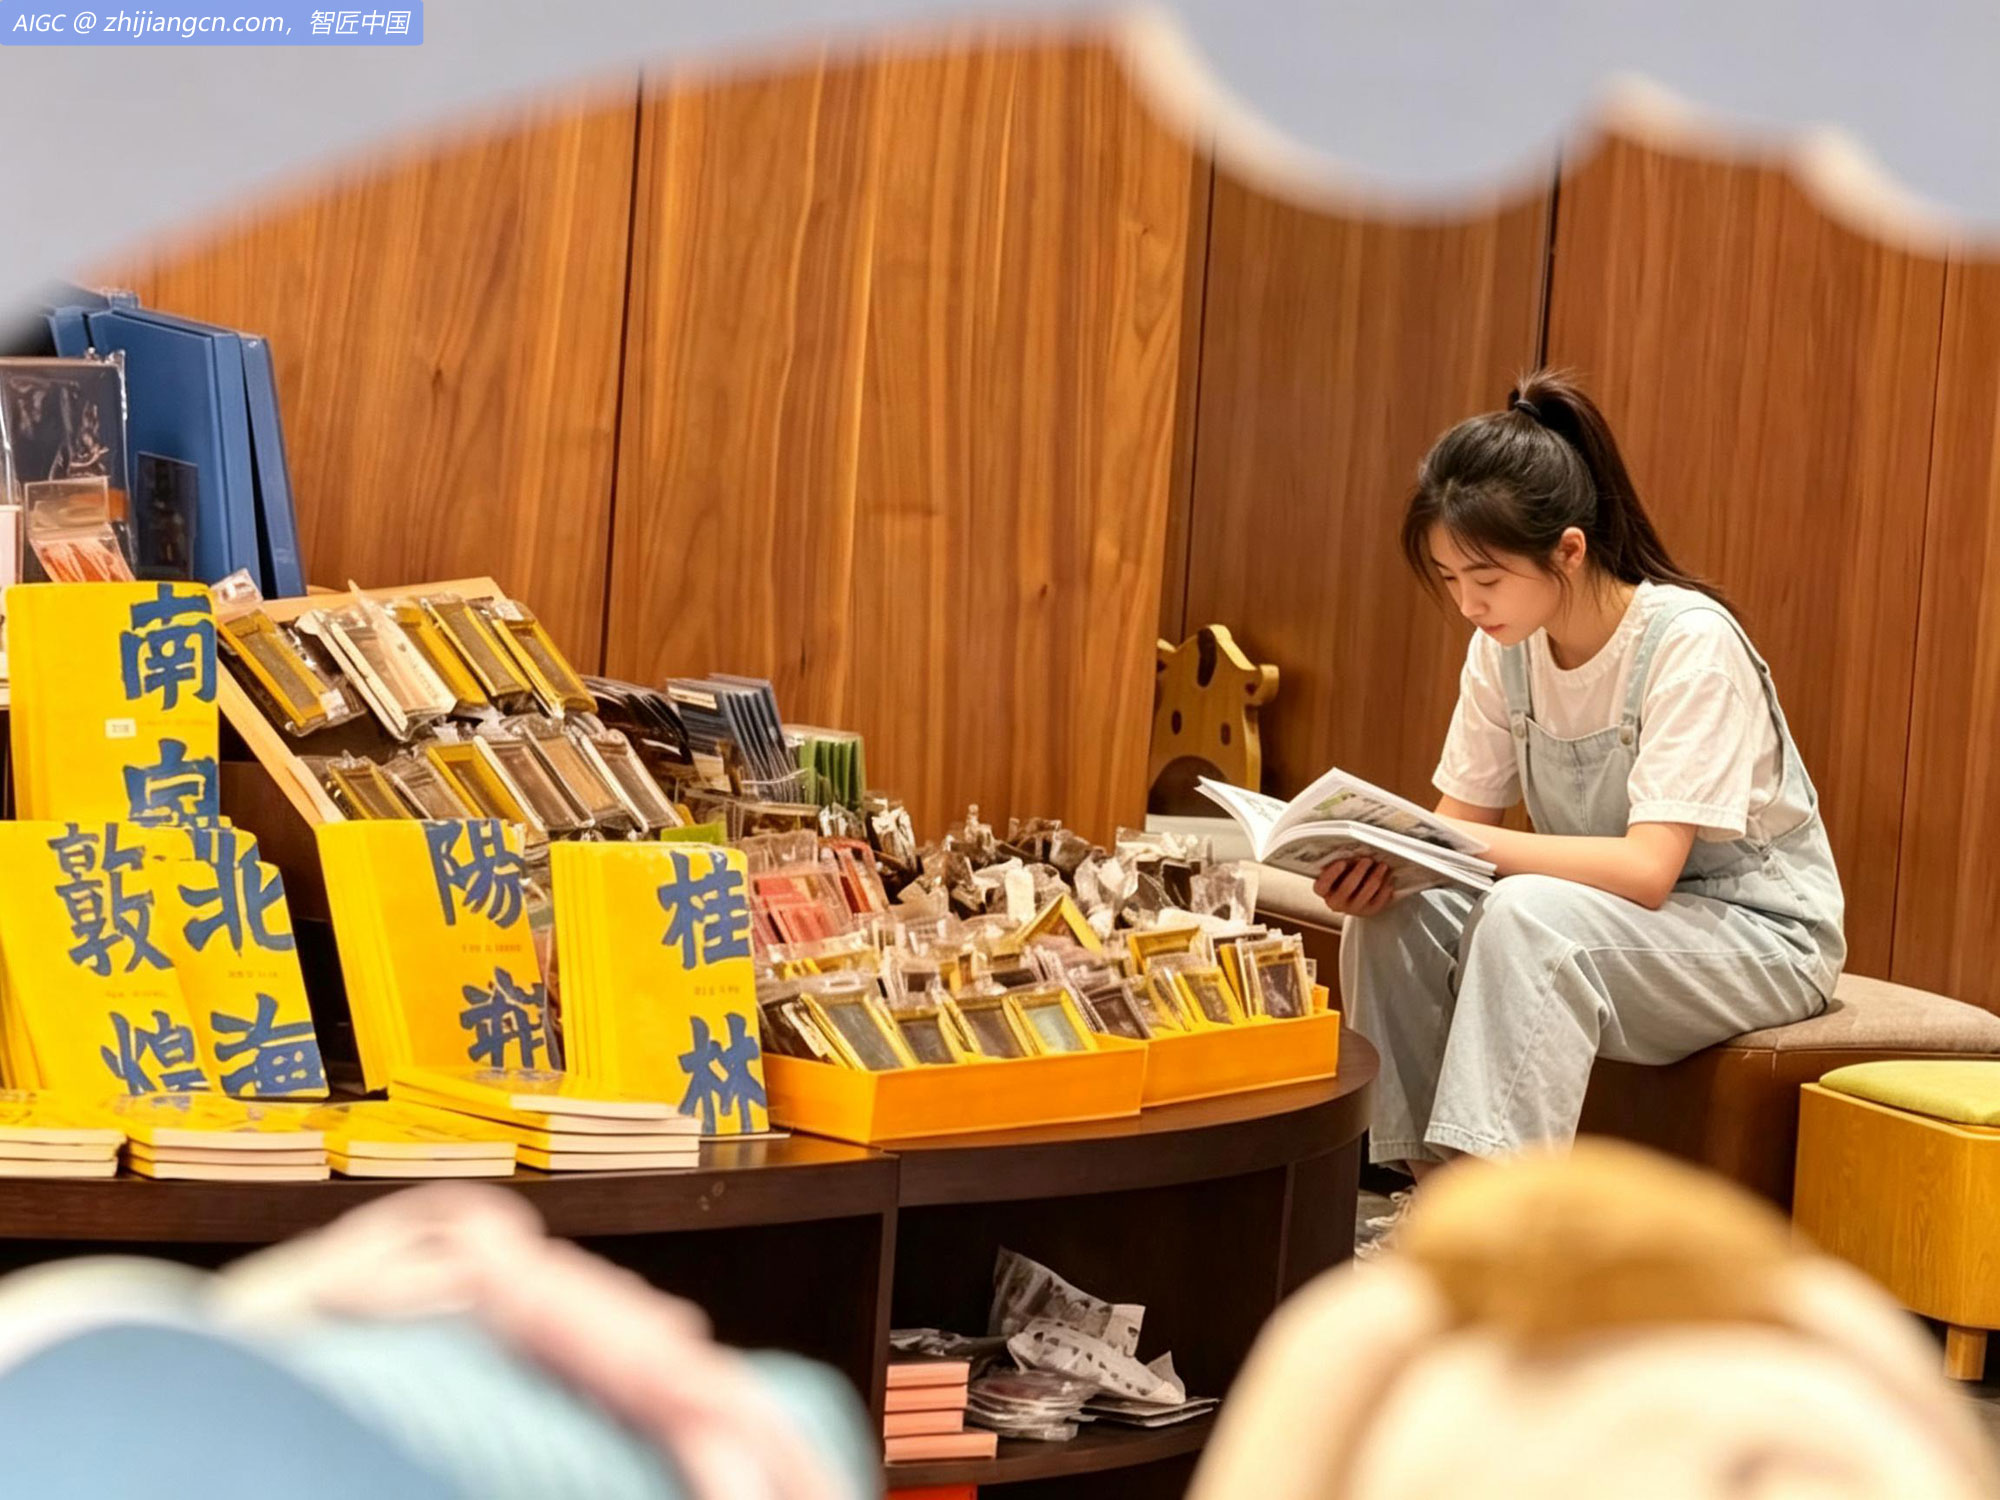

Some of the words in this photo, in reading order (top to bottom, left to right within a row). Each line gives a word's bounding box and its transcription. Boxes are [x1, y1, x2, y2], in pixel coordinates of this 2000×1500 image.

[47, 821, 213, 1096] 敦煌
[178, 856, 325, 1096] 北海
[657, 850, 767, 1135] 桂林
